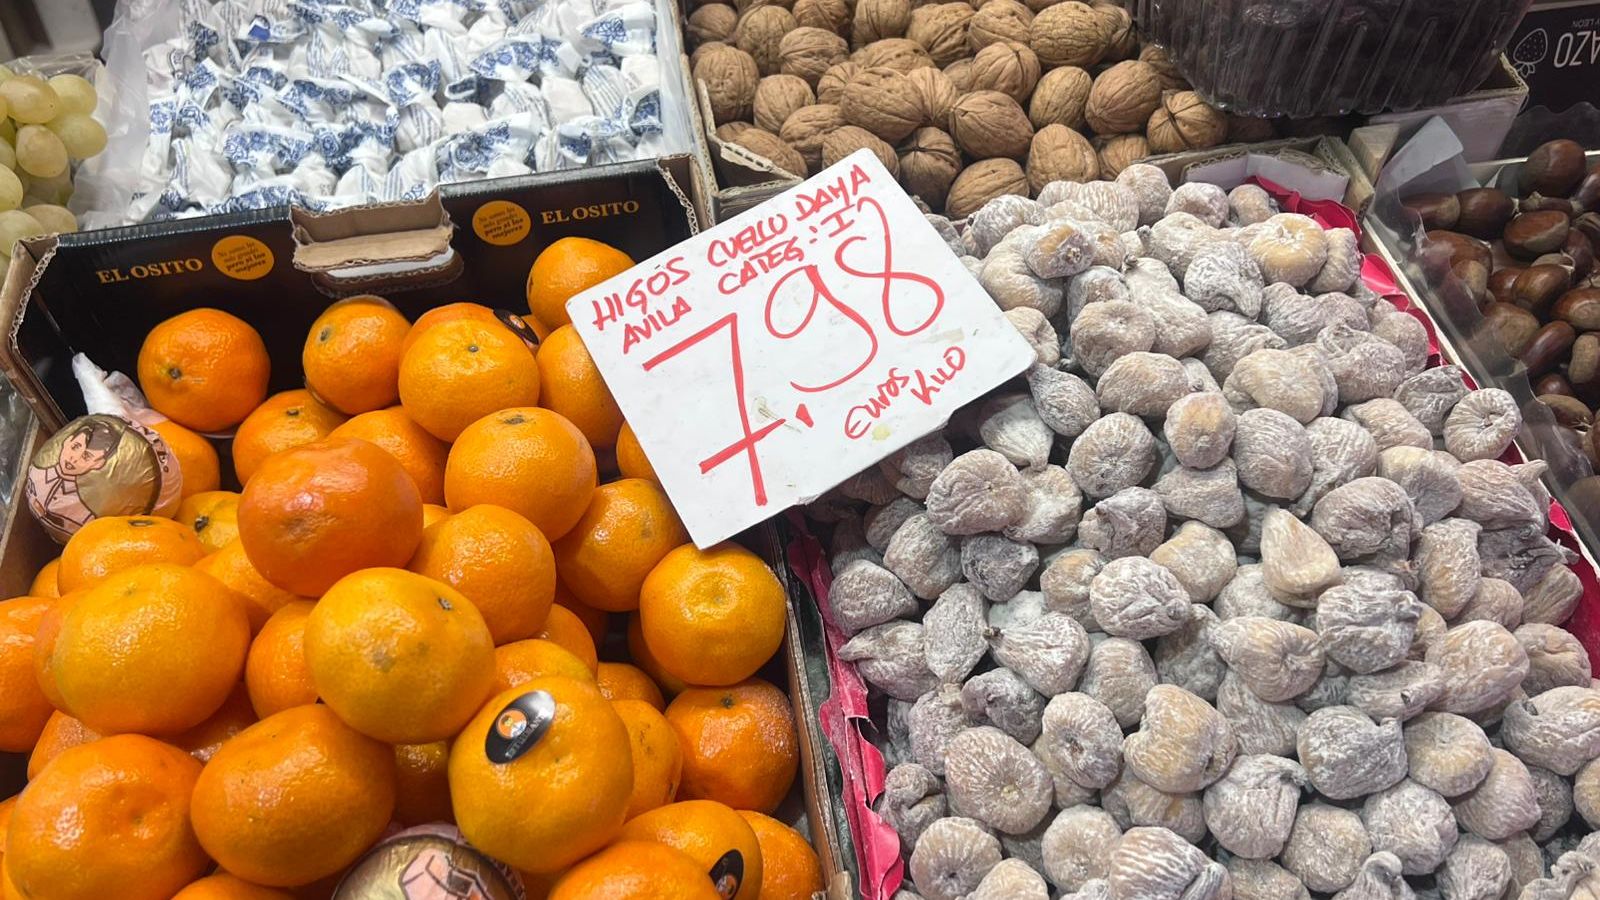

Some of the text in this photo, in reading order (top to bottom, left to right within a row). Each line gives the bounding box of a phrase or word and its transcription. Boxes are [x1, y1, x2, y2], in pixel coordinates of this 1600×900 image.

[540, 200, 640, 225] EL OSITO
[593, 165, 870, 332] HIGOS CUELLO DAMA
[96, 258, 204, 284] EL OSITO
[624, 296, 692, 355] AVILA
